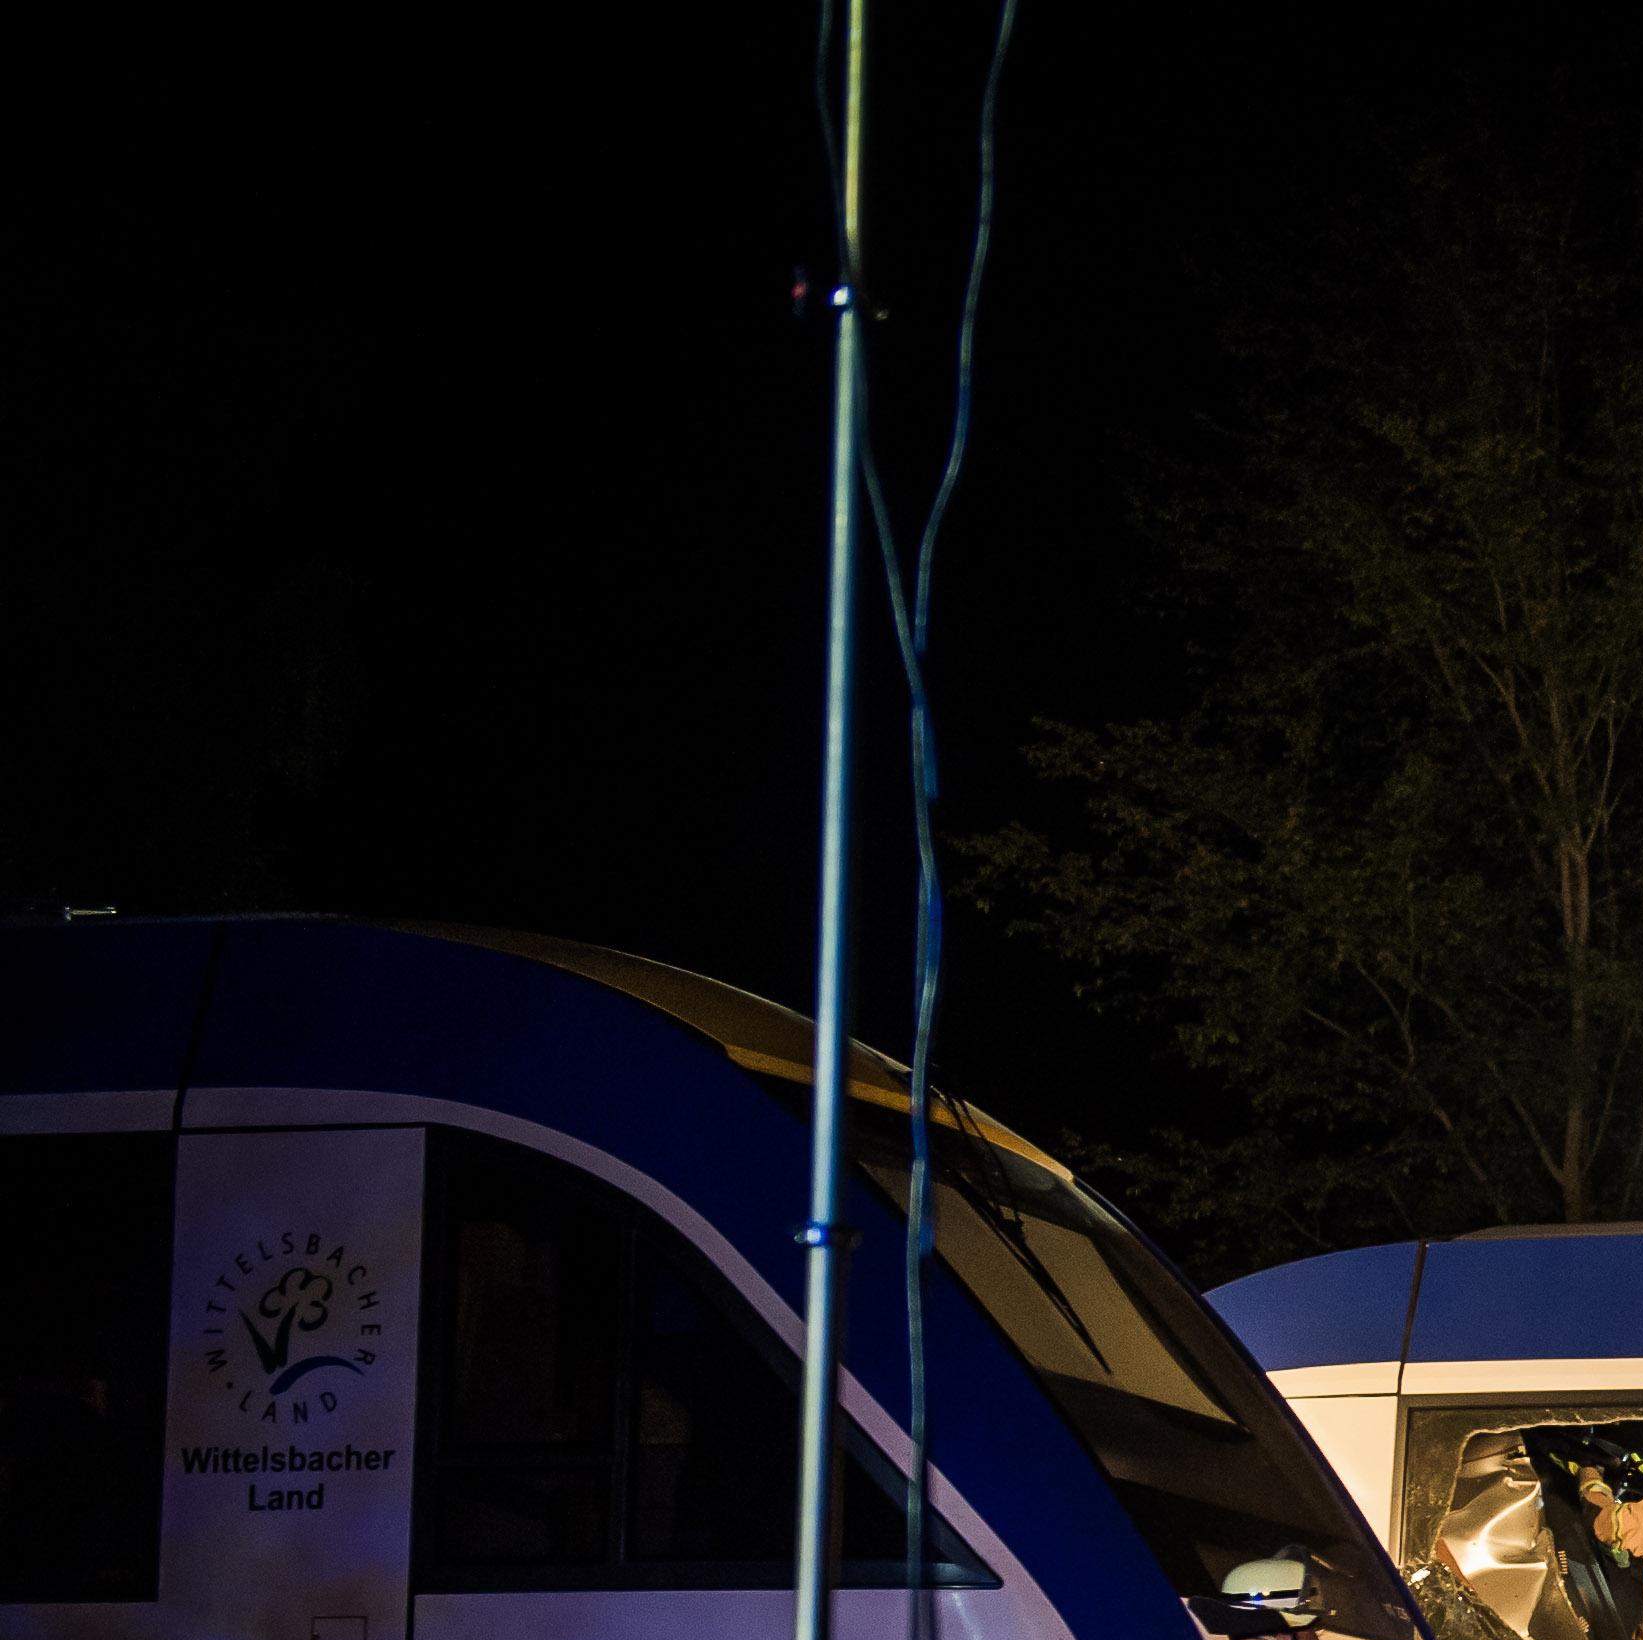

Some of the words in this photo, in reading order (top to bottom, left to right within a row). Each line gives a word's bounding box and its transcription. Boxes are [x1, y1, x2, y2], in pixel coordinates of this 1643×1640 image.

[203, 1232, 381, 1372] WITTELSBACHER
[238, 1391, 338, 1424] LAND
[181, 1446, 396, 1474] Wittelsbacher
[249, 1483, 325, 1511] Land
